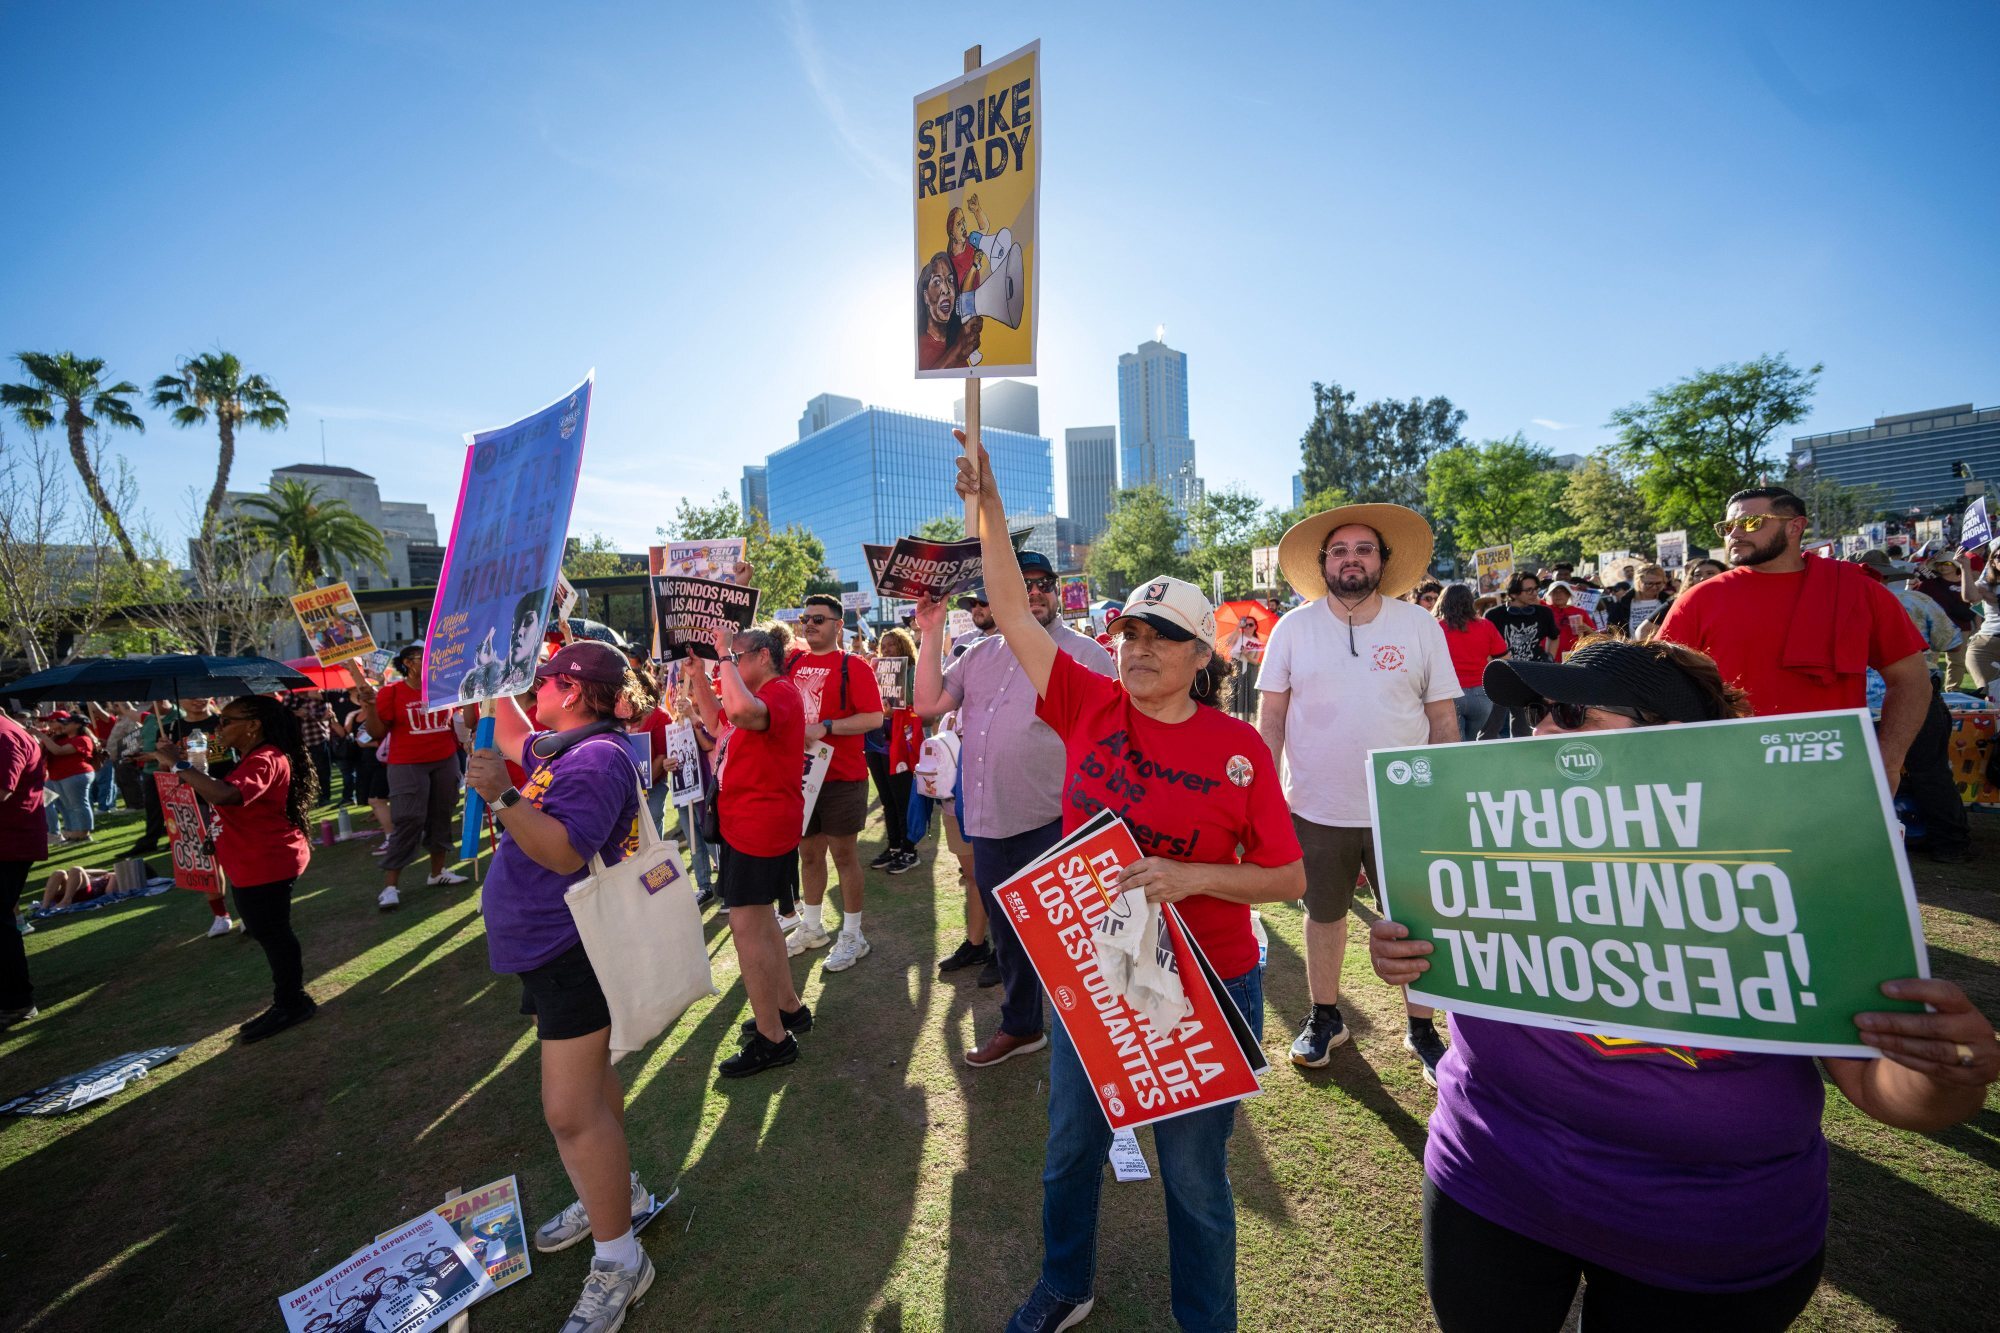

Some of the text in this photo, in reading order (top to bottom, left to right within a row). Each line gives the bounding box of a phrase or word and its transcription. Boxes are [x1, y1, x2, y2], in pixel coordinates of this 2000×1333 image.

[918, 78, 1031, 160] STRIKE
[918, 124, 1032, 200] READY
[671, 547, 735, 561] UTLA SEIU
[895, 553, 957, 574] UNIDOS
[294, 587, 351, 612] WE CAN'T
[659, 578, 750, 606] MÁS FONDOS PARA
[301, 604, 336, 624] WAIT
[671, 598, 725, 618] LAS AULAS,
[677, 613, 740, 635] CONTRATOS
[674, 629, 716, 646] PRIVADOS
[797, 666, 831, 677] JUNTOS
[877, 661, 902, 672] FAIR PAY
[881, 673, 896, 685] FAIR
[880, 685, 902, 698] NTRACT
[1759, 730, 1841, 746] LOCAL 99
[1561, 753, 1597, 769] UTLA
[1765, 741, 1845, 764] SEIU
[1080, 751, 1106, 778] to
[166, 801, 199, 827] REAL
[1466, 782, 1703, 849] AHORA!
[174, 840, 194, 870] SO
[185, 873, 216, 887] LAUSD
[1005, 893, 1020, 913] LOCAL
[1009, 890, 1031, 920] SEIU
[1427, 859, 1799, 934] COMPLETO
[1431, 926, 1818, 1025] ¡PERSONAL
[1031, 871, 1166, 1110] LOS ESTUDIANTES
[1058, 987, 1073, 1008] UTLA
[1184, 1041, 1226, 1085] LA
[1157, 1059, 1201, 1104] DE
[437, 1183, 512, 1223] CAN'T
[290, 1294, 308, 1309] END
[308, 1284, 324, 1298] THE
[324, 1253, 372, 1287] DETENTIONS
[373, 1249, 380, 1257] &
[381, 1219, 433, 1253] DEPORTATIONS
[385, 1293, 413, 1314] HUMAN
[389, 1296, 401, 1306] NO
[391, 1299, 415, 1316] BEING
[401, 1307, 410, 1315] IS
[424, 1281, 480, 1320] TOGETHER
[392, 1303, 425, 1328] ILLEGAL!
